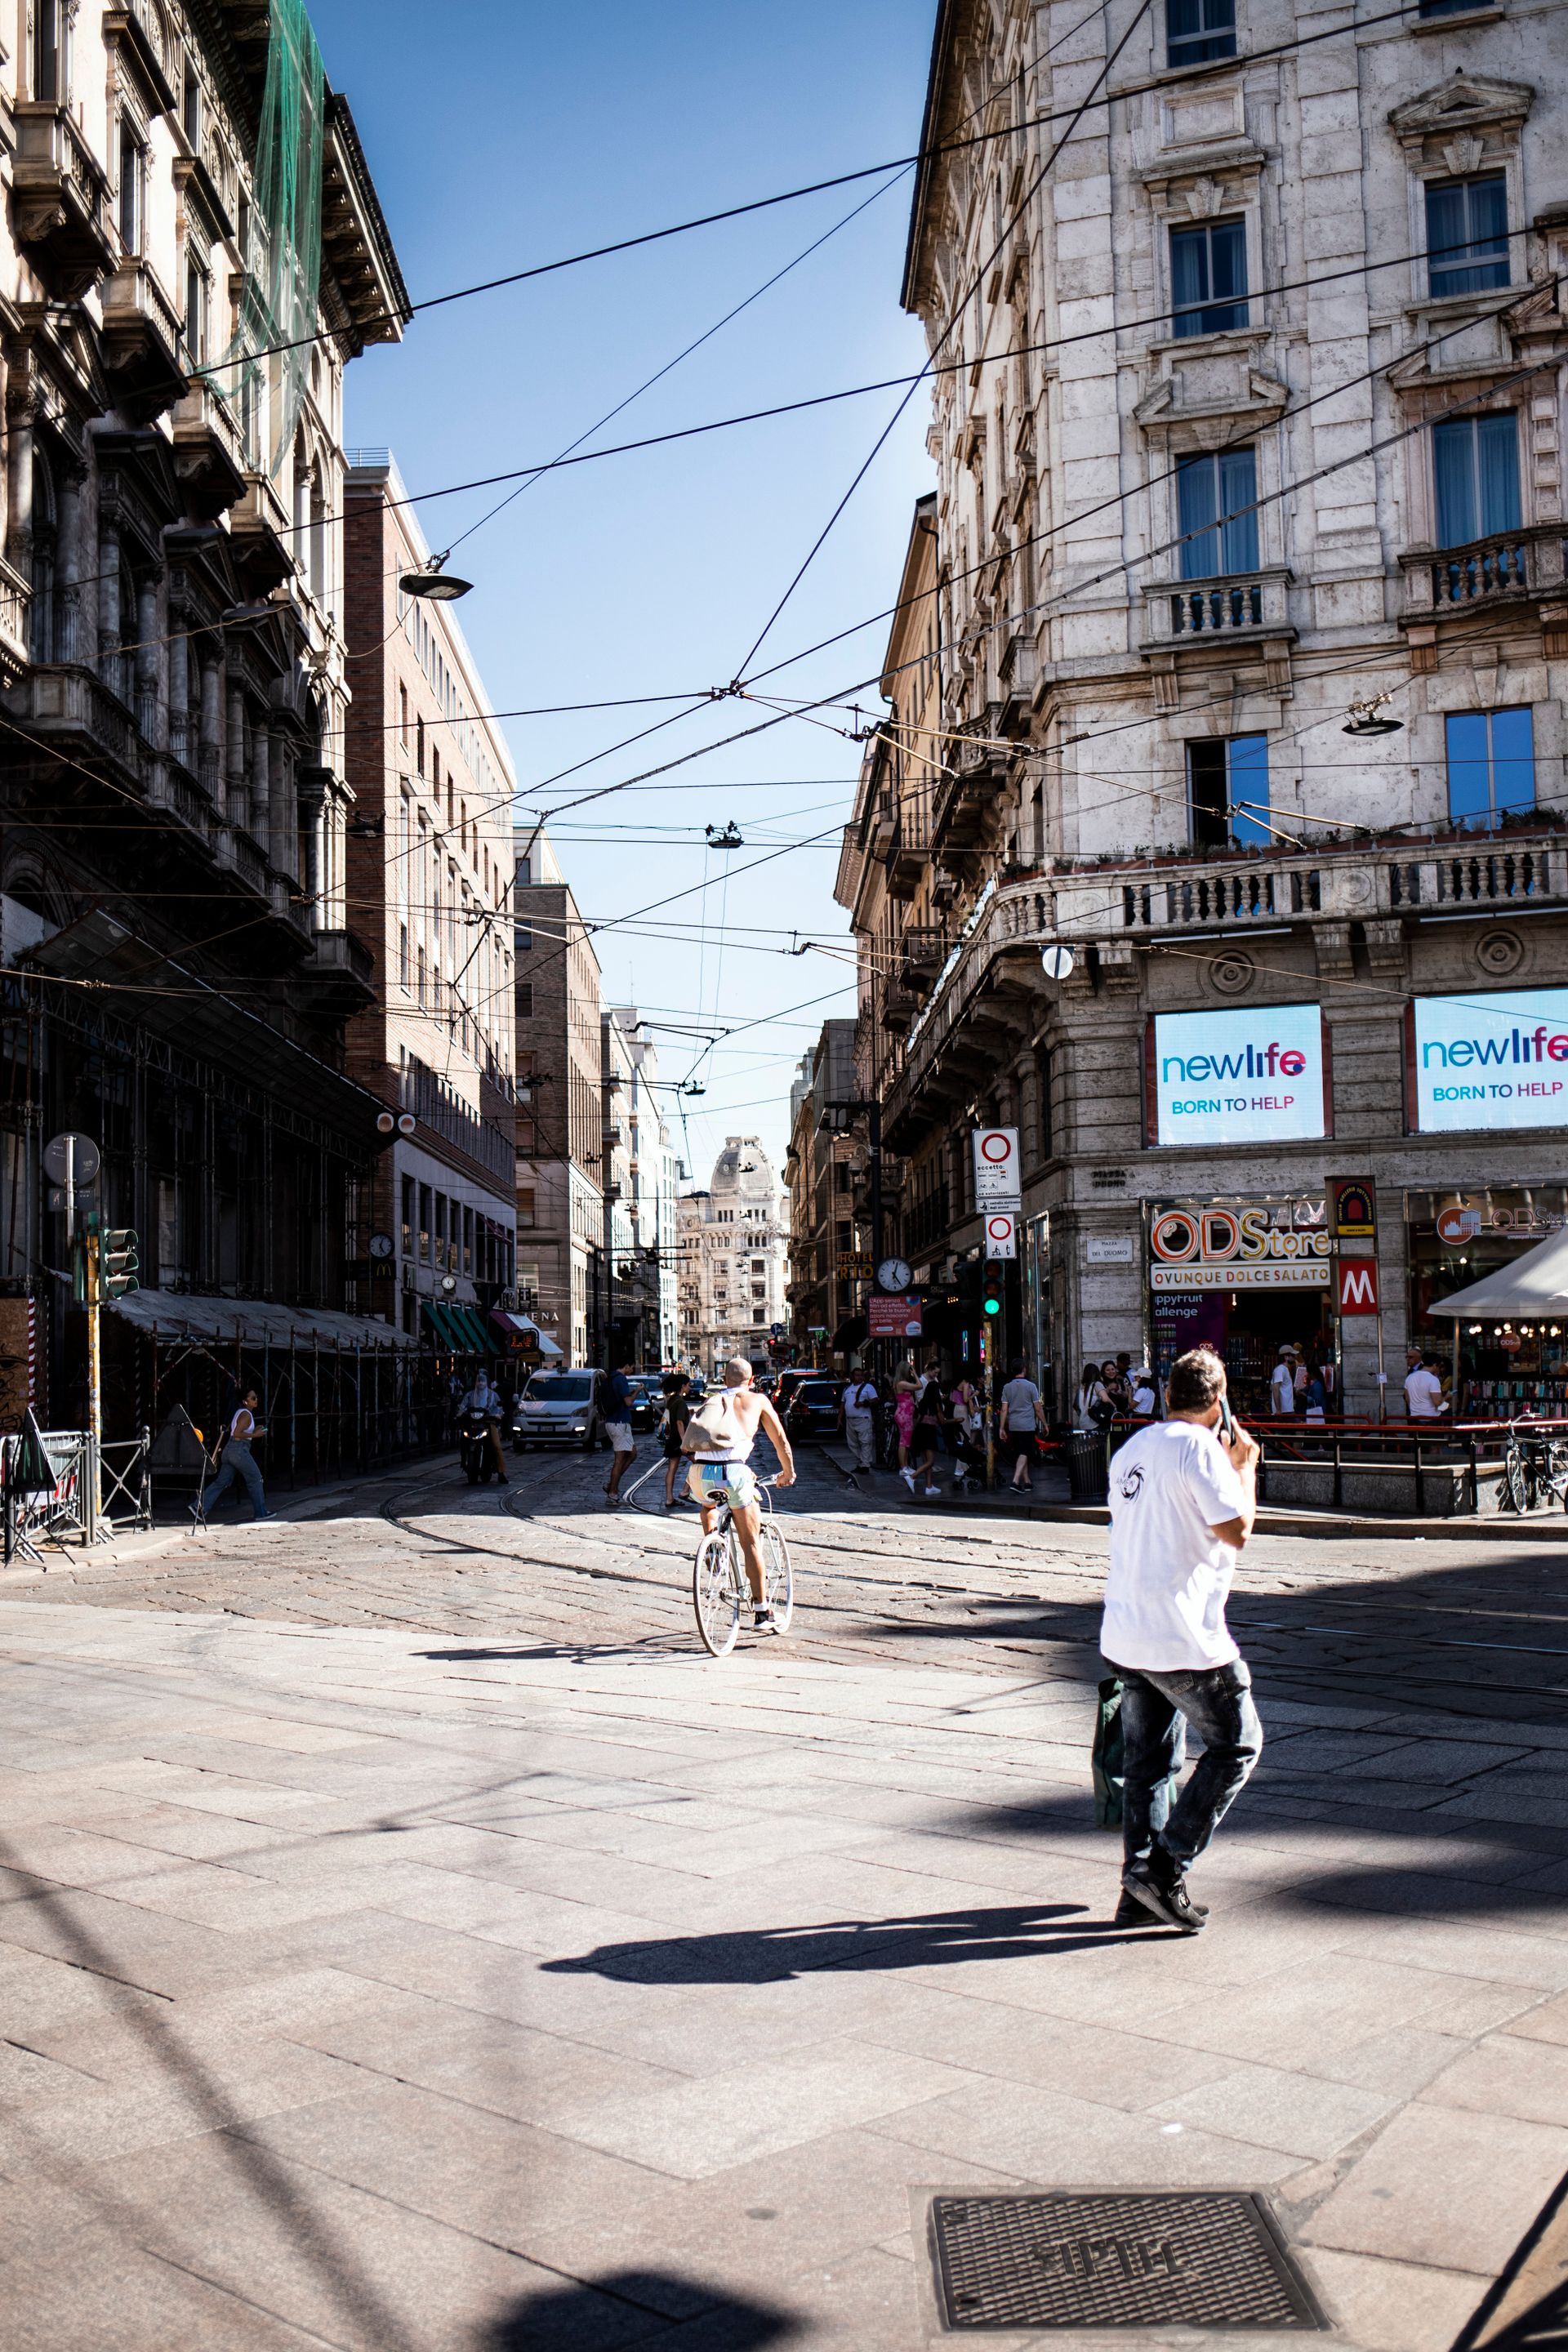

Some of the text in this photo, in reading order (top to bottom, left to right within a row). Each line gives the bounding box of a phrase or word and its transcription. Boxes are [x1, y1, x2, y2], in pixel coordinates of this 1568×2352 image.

[1423, 1027, 1568, 1068] newlife
[1163, 1042, 1307, 1083] newlife
[1433, 1082, 1564, 1102] BORN TO HELP
[1172, 1096, 1294, 1114] BORN TO HELP
[1092, 1170, 1126, 1178] PIAZZA
[1093, 1180, 1126, 1188] DUOMO
[1152, 1209, 1330, 1263] ODStore
[840, 1254, 874, 1263] HOTEL
[840, 1266, 874, 1280] RIO
[1155, 1268, 1329, 1285] OVUNQUE DOLCE SALATO
[1342, 1270, 1375, 1304] M
